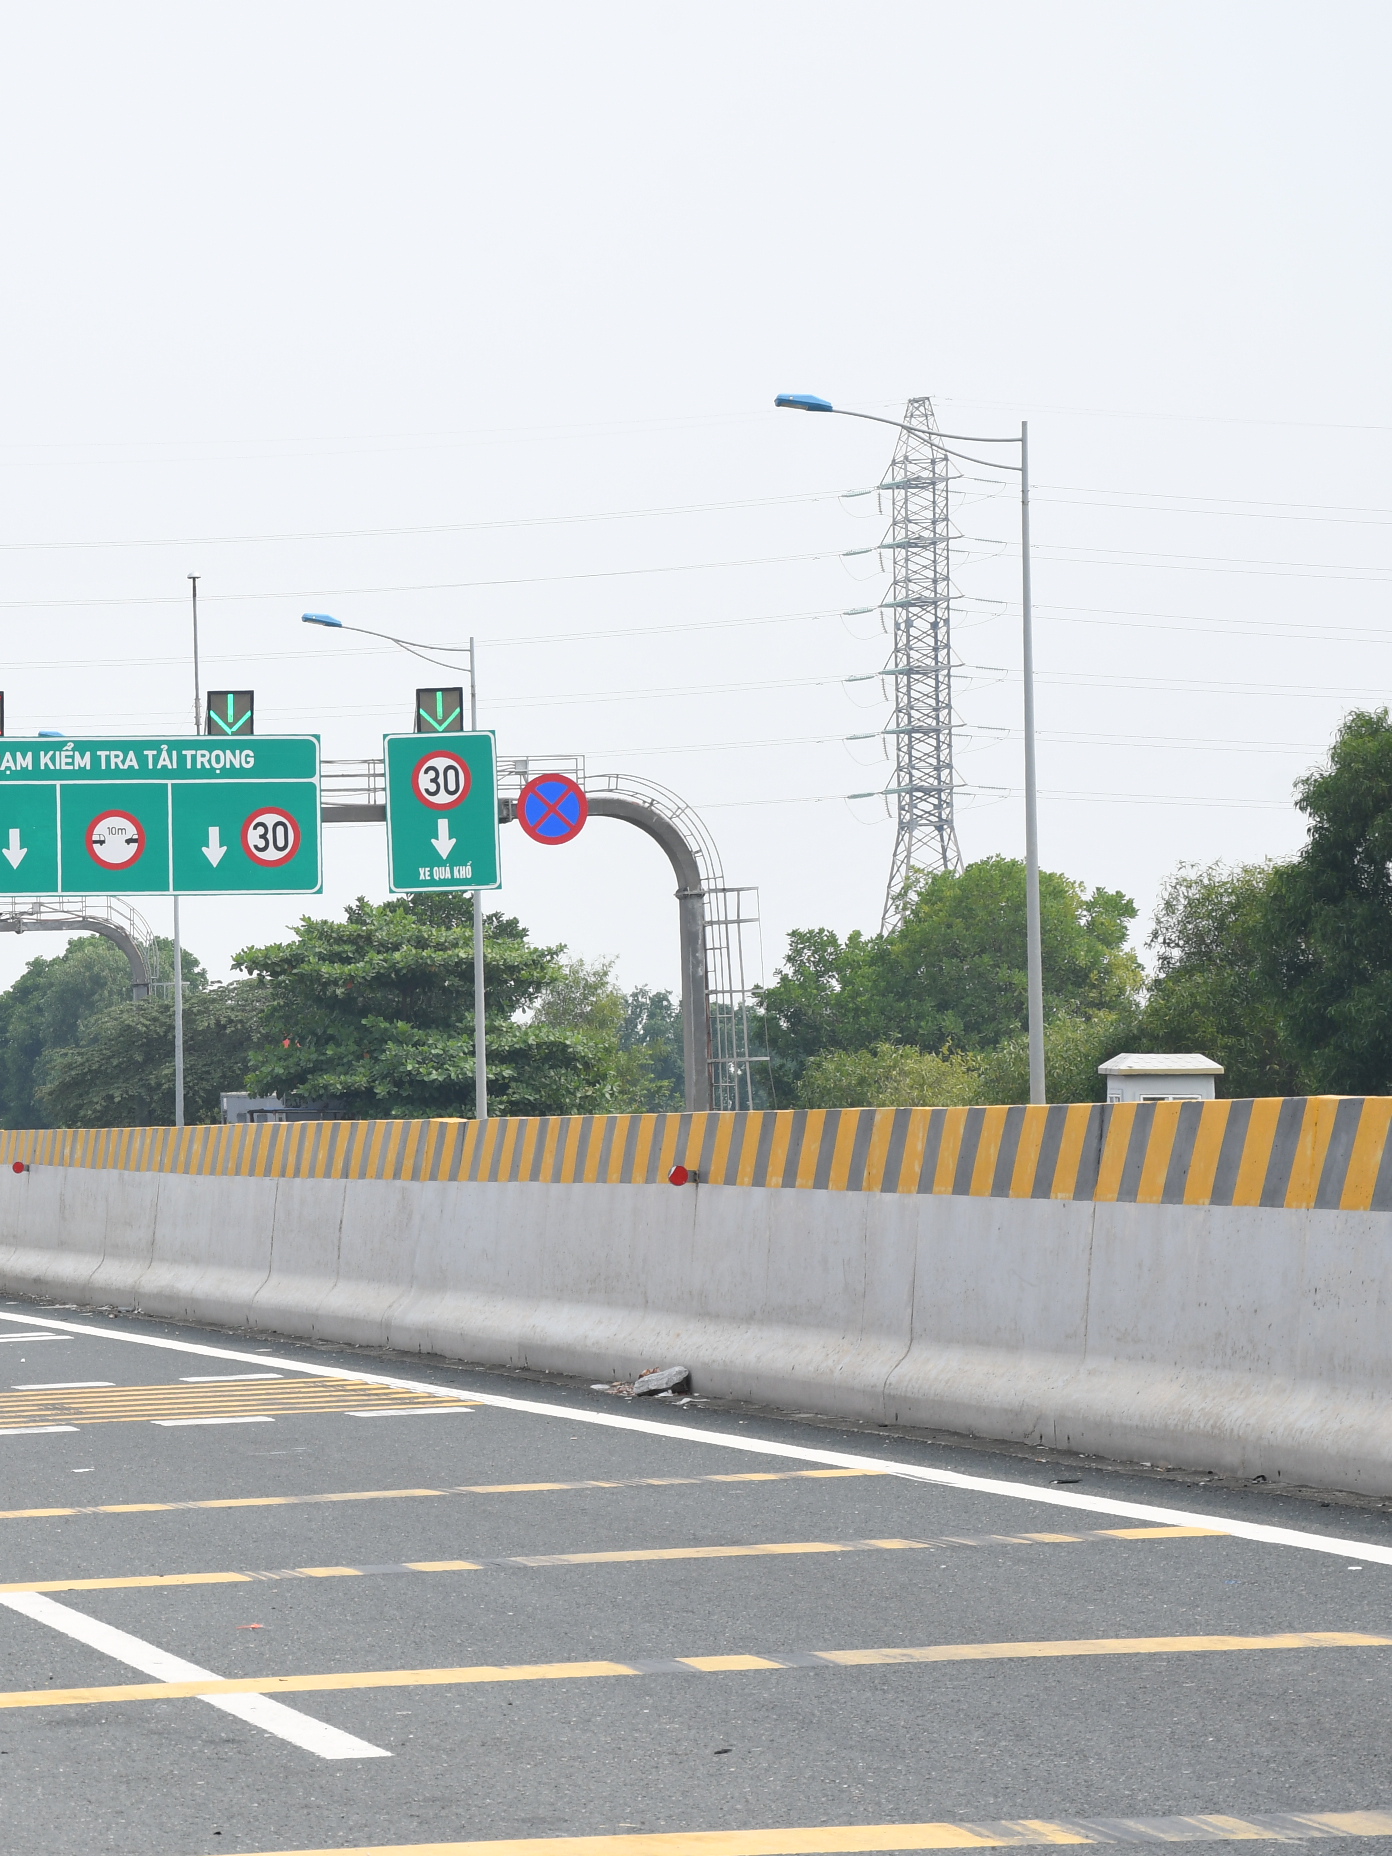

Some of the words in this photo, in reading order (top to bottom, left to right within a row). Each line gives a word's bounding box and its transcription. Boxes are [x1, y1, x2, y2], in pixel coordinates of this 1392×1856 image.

[39, 742, 91, 770] KIỂM
[96, 750, 139, 770] TRA
[143, 744, 177, 769] TẢI
[181, 749, 255, 774] TRỌNG
[423, 764, 460, 797] 30
[107, 826, 127, 836] 10m
[252, 821, 289, 853] 30
[419, 867, 431, 880] XE
[433, 864, 451, 880] QUÁ
